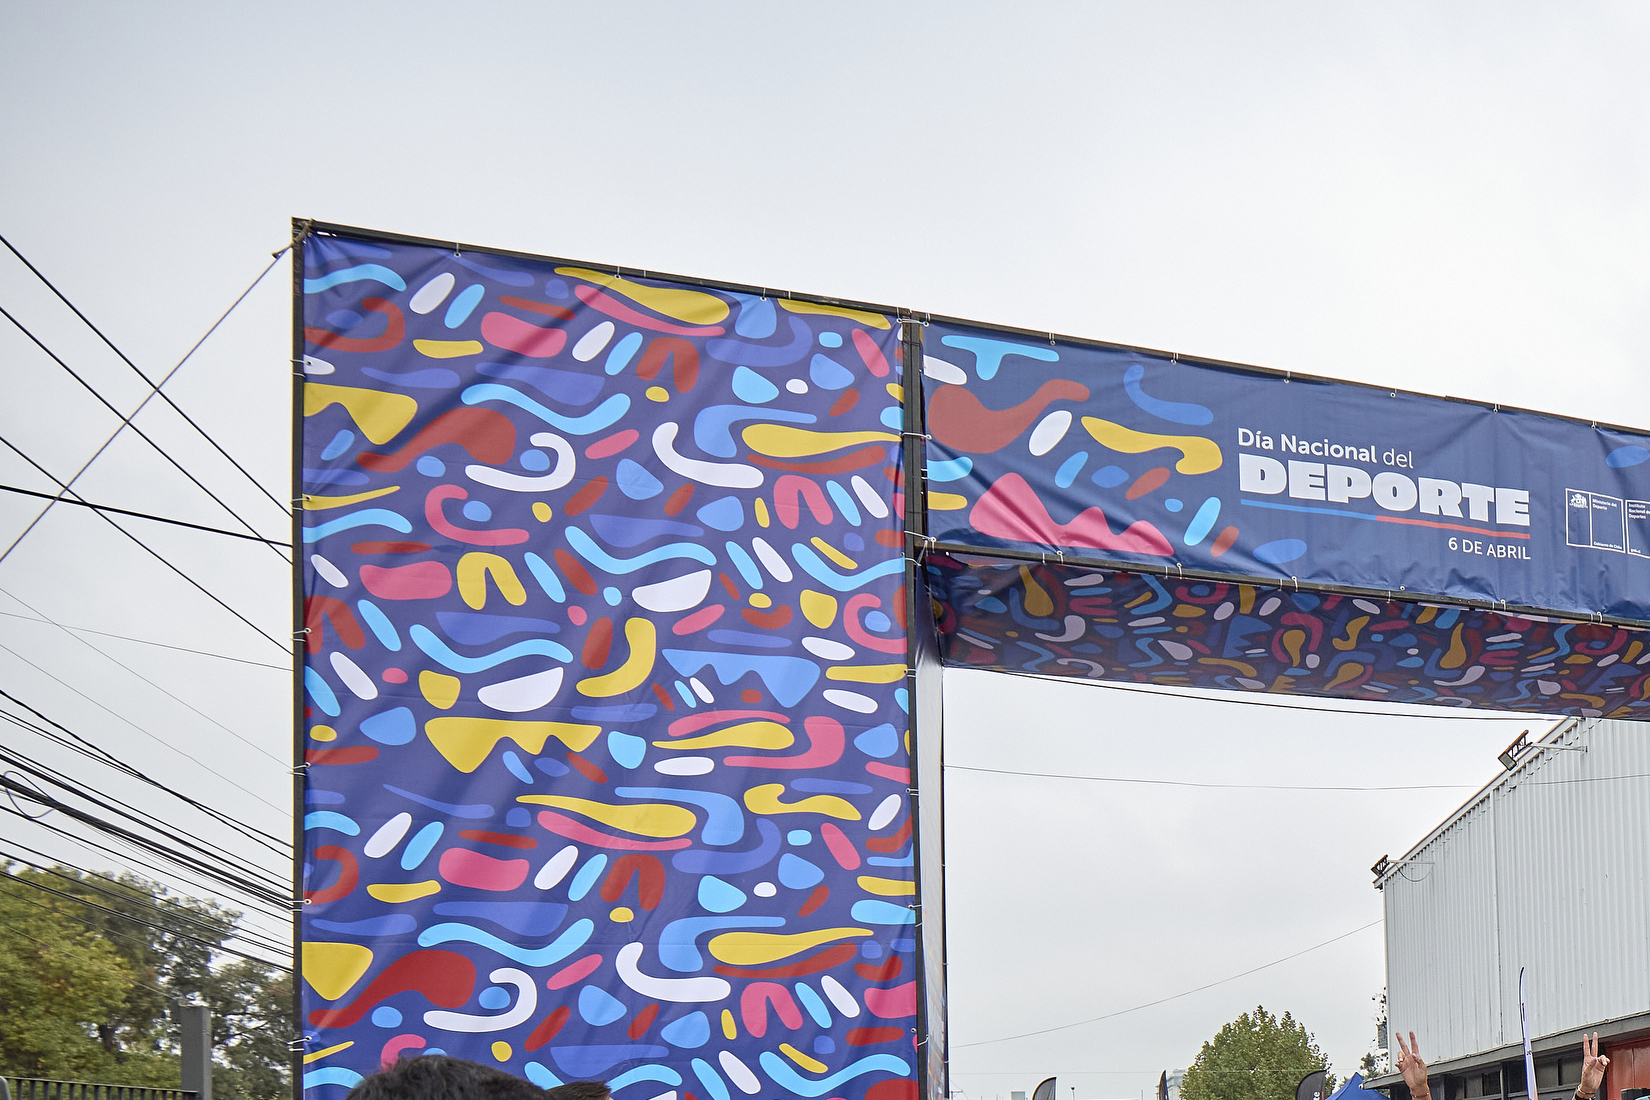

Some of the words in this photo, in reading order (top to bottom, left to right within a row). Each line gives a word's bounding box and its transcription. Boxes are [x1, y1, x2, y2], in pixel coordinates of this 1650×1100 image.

[1238, 427, 1274, 450] Día
[1280, 433, 1377, 464] Nacional
[1383, 447, 1414, 469] del
[1239, 453, 1531, 526] DEPORTE
[1448, 536, 1458, 552] 6
[1462, 538, 1482, 555] DE
[1487, 541, 1531, 560] ABRIL
